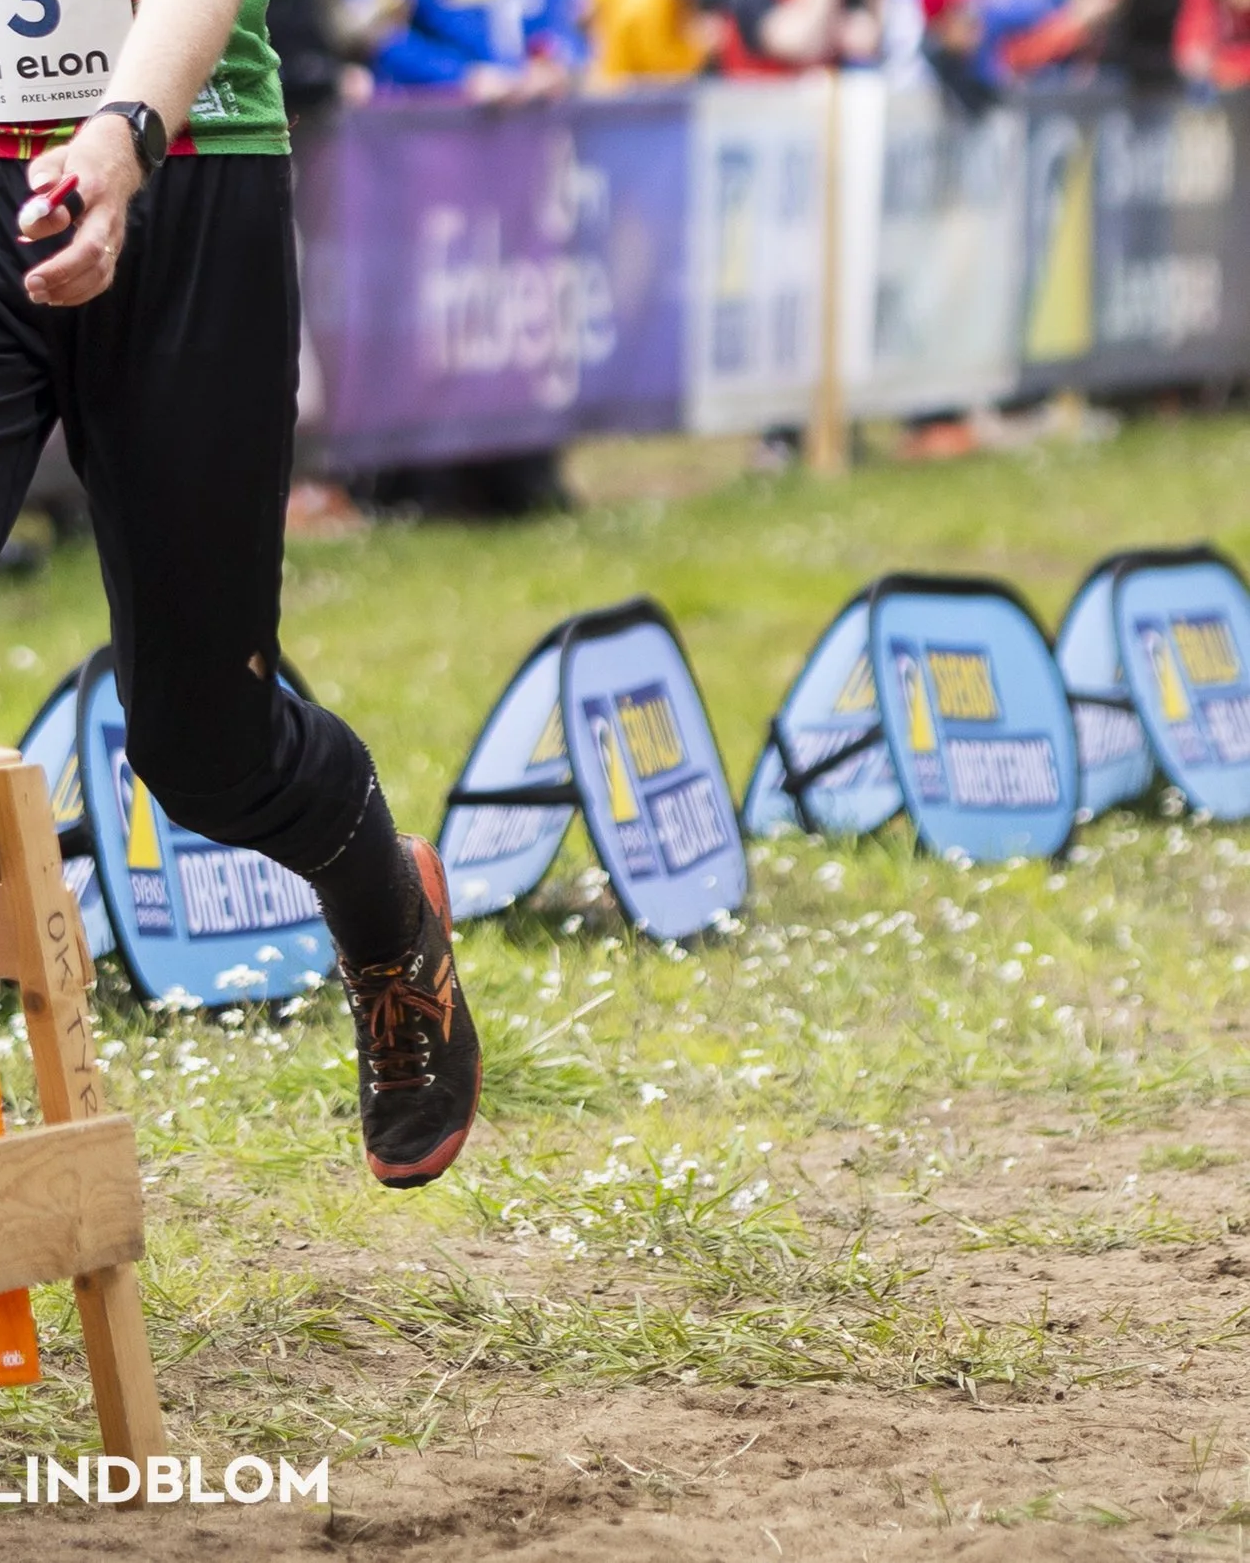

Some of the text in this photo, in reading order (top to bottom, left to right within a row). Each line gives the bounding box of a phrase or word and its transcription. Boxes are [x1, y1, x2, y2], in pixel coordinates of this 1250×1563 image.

[177, 847, 324, 935] ORIENTERIN
[47, 910, 98, 1118] OK TYR
